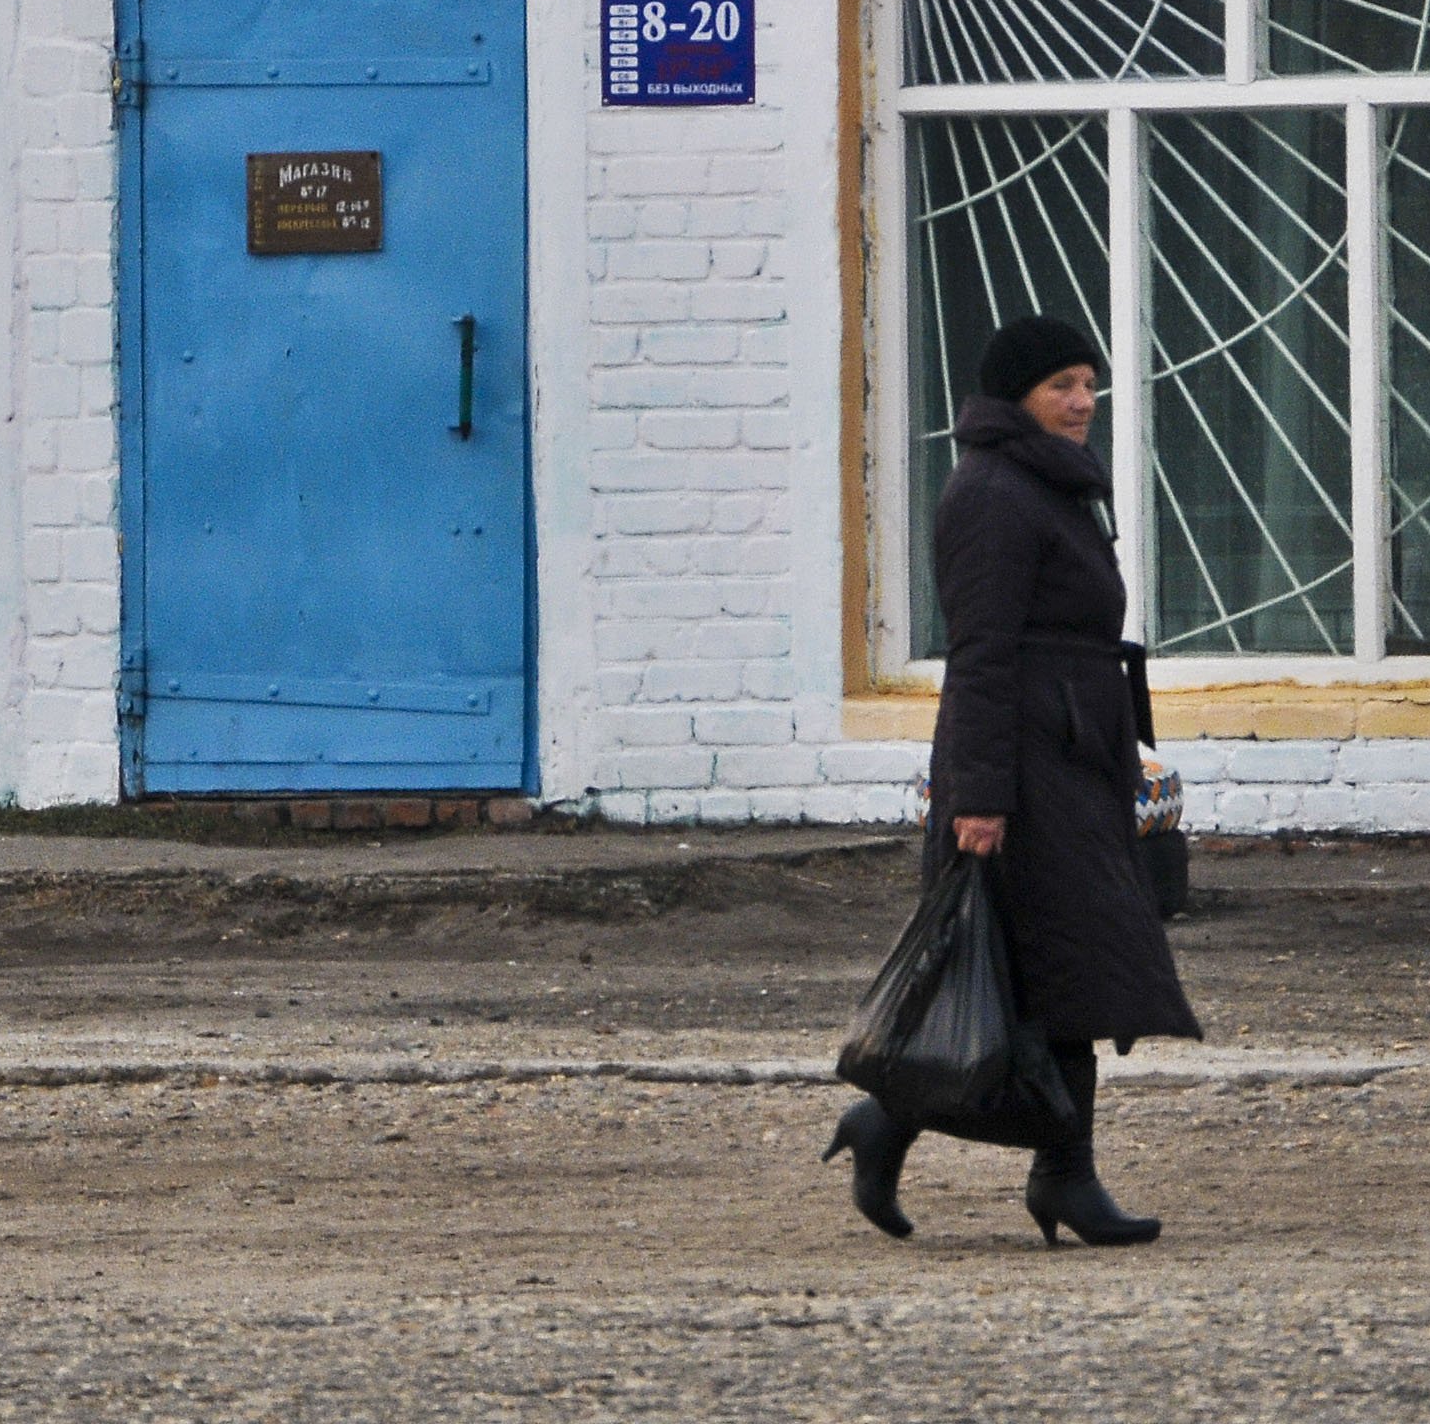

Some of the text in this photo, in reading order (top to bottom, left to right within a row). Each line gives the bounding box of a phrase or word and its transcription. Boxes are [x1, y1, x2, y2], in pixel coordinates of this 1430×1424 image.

[642, 1, 740, 42] 8-20
[647, 83, 744, 94] БЕЗ ВЫХОДНЫХ
